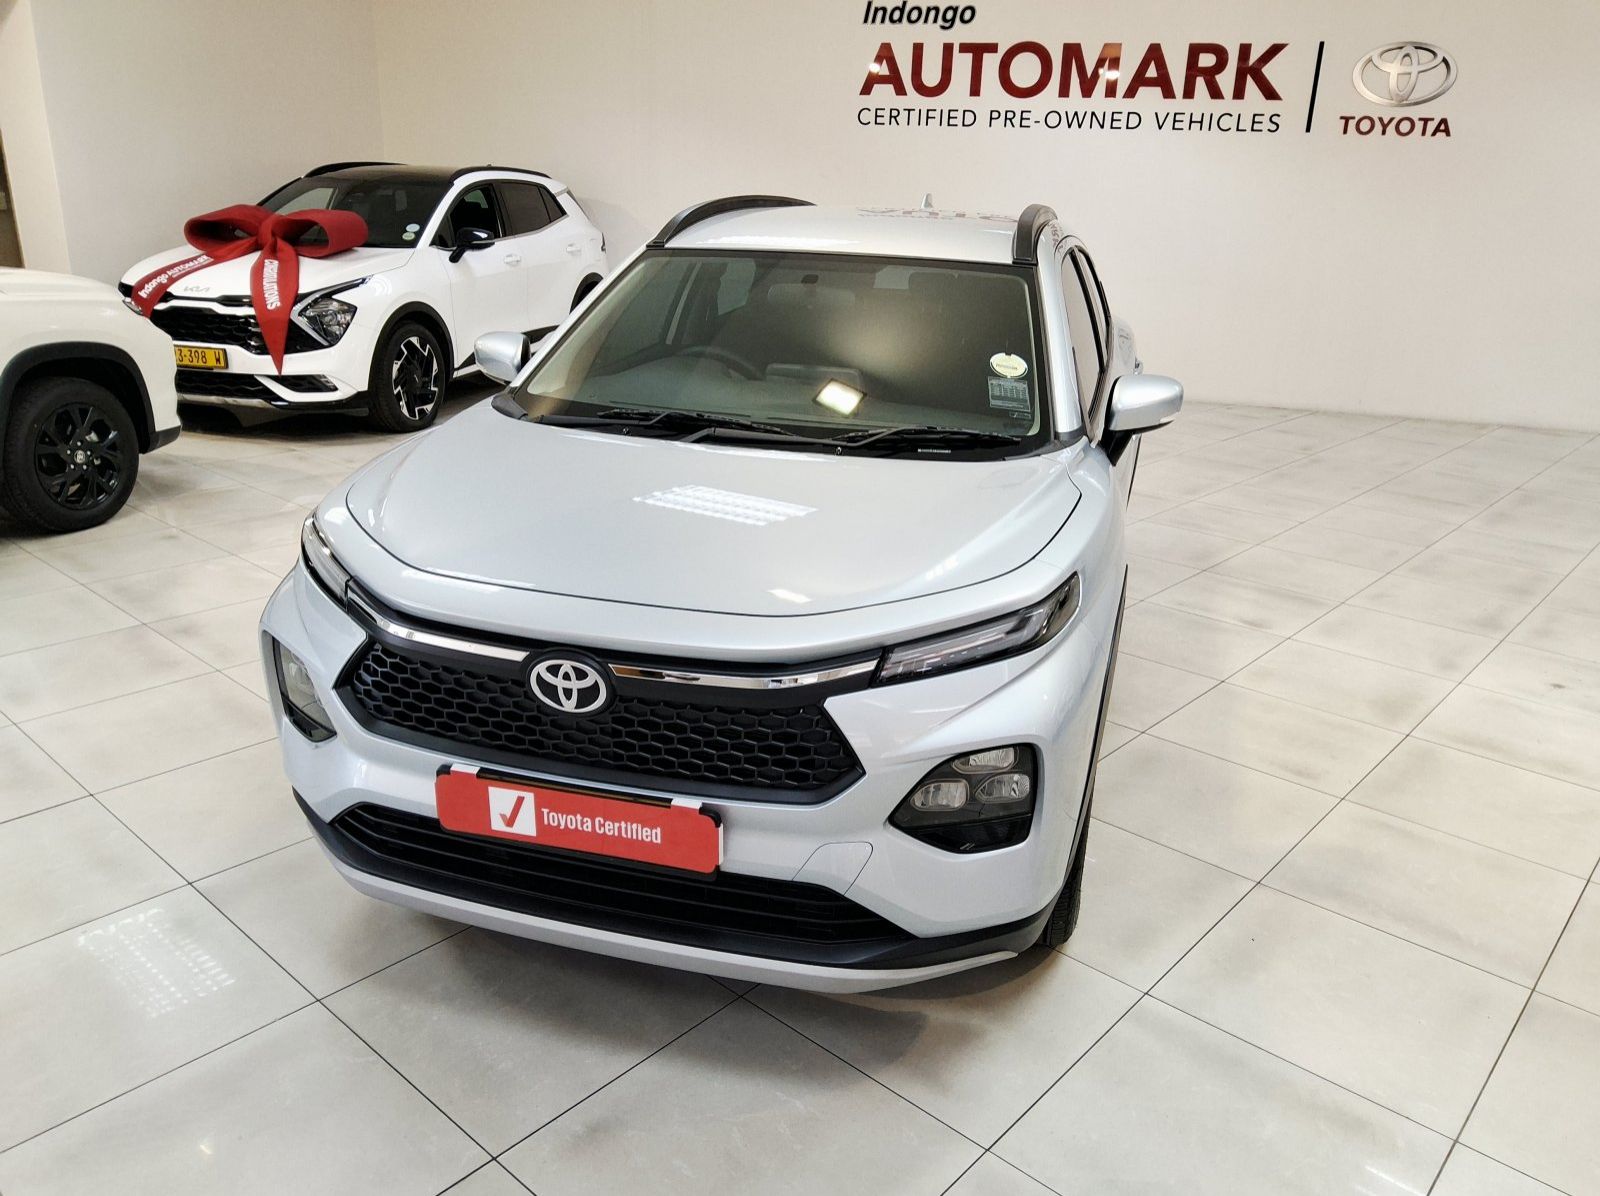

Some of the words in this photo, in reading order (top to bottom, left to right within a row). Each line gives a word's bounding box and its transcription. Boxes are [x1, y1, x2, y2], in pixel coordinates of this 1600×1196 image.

[863, 0, 977, 30] Indongo
[859, 41, 1289, 101] AUTOMARK
[857, 107, 977, 127] CERTIFIED
[988, 109, 1142, 131] PRE-OWNED
[1154, 111, 1281, 133] VEHICLES
[1339, 115, 1452, 138] TOYOTA
[137, 273, 169, 299] Indongo
[176, 348, 208, 364] 3-398
[213, 350, 221, 365] W
[541, 808, 592, 832] Toyota
[594, 817, 661, 844] Certified
